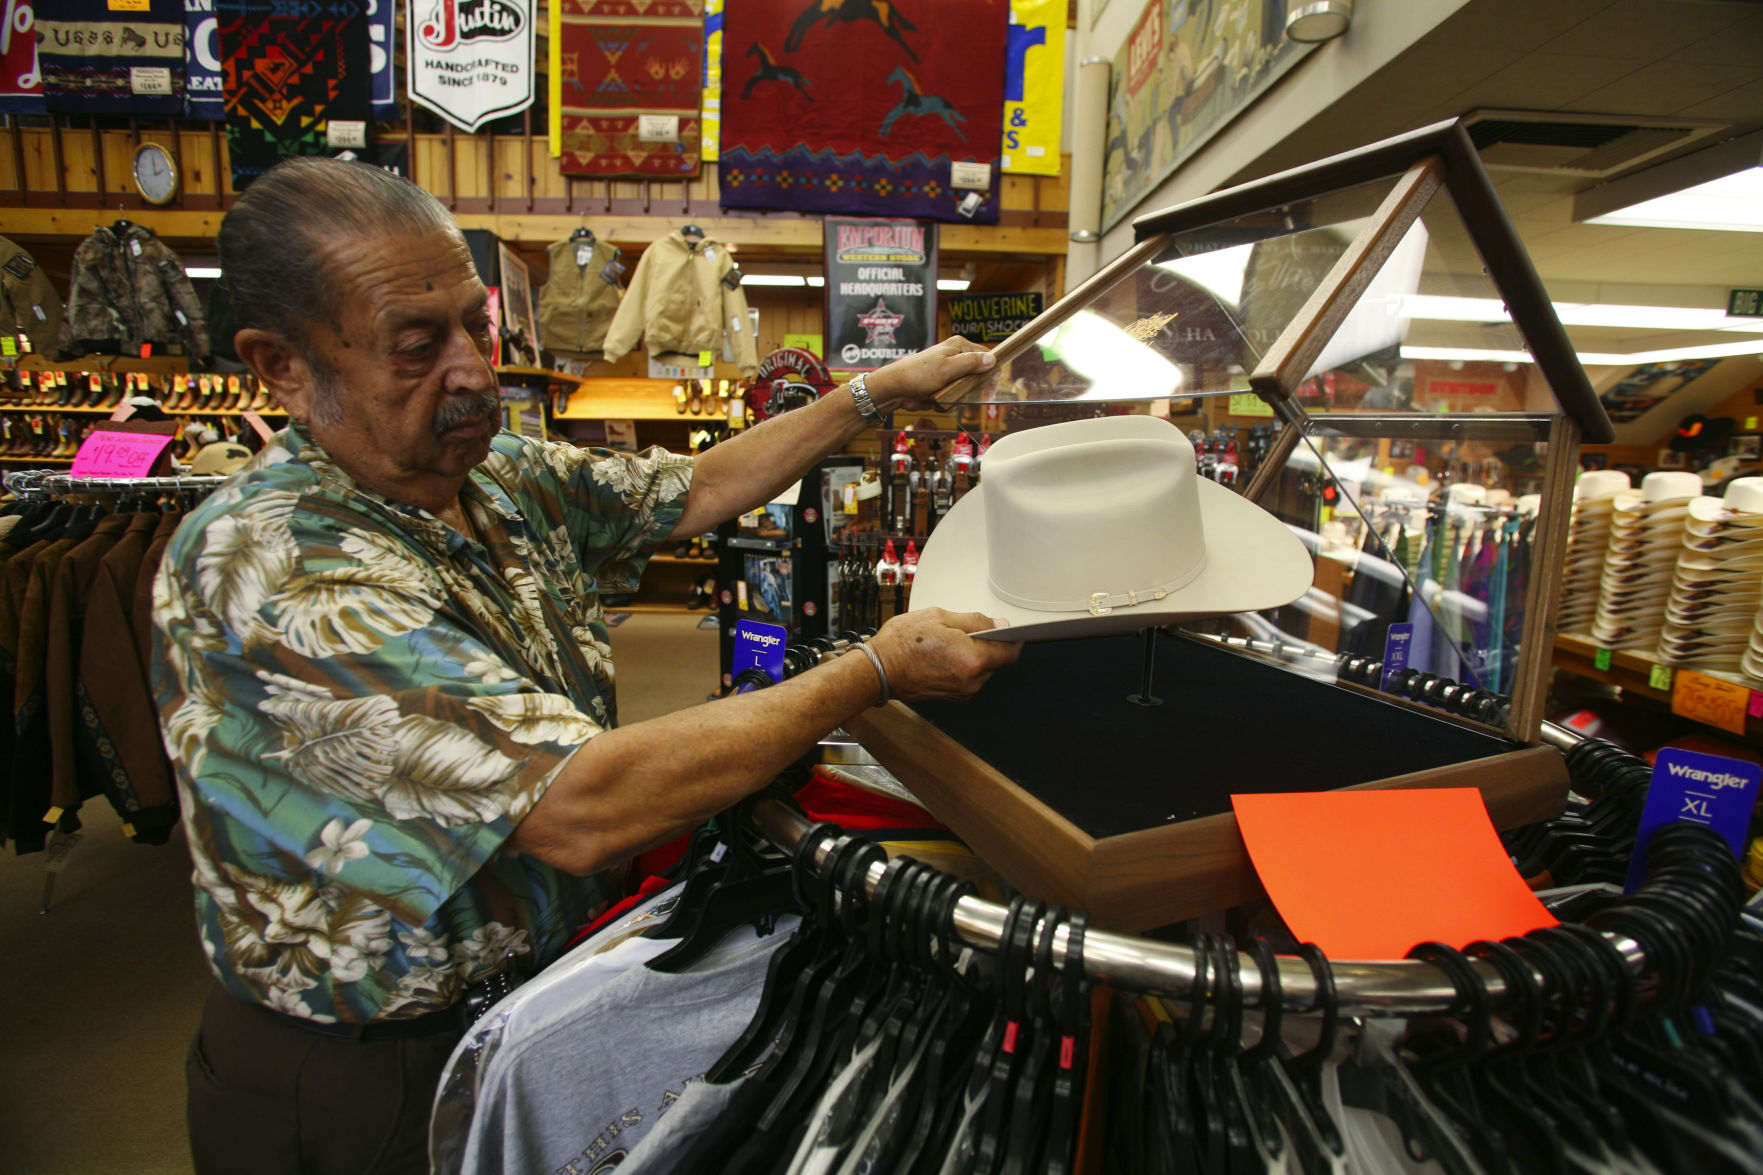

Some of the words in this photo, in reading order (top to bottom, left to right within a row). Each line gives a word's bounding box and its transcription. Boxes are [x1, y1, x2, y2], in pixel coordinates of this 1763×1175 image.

[423, 0, 517, 46] Justin
[424, 59, 520, 73] HANDCAFTED
[438, 75, 473, 87] SINC
[837, 226, 925, 252] EMPORIUM
[858, 267, 906, 280] OFFICIAL
[840, 282, 923, 297] HEADQUARTERS
[948, 294, 1038, 320] WOLVERINE
[760, 352, 812, 378] ORIGINAL
[741, 629, 781, 647] Wrangler
[1390, 632, 1410, 644] Wrangler
[754, 655, 762, 667] L
[1668, 762, 1749, 790] Wrangler
[1681, 797, 1713, 818] XL
[556, 1107, 644, 1175] THIS
